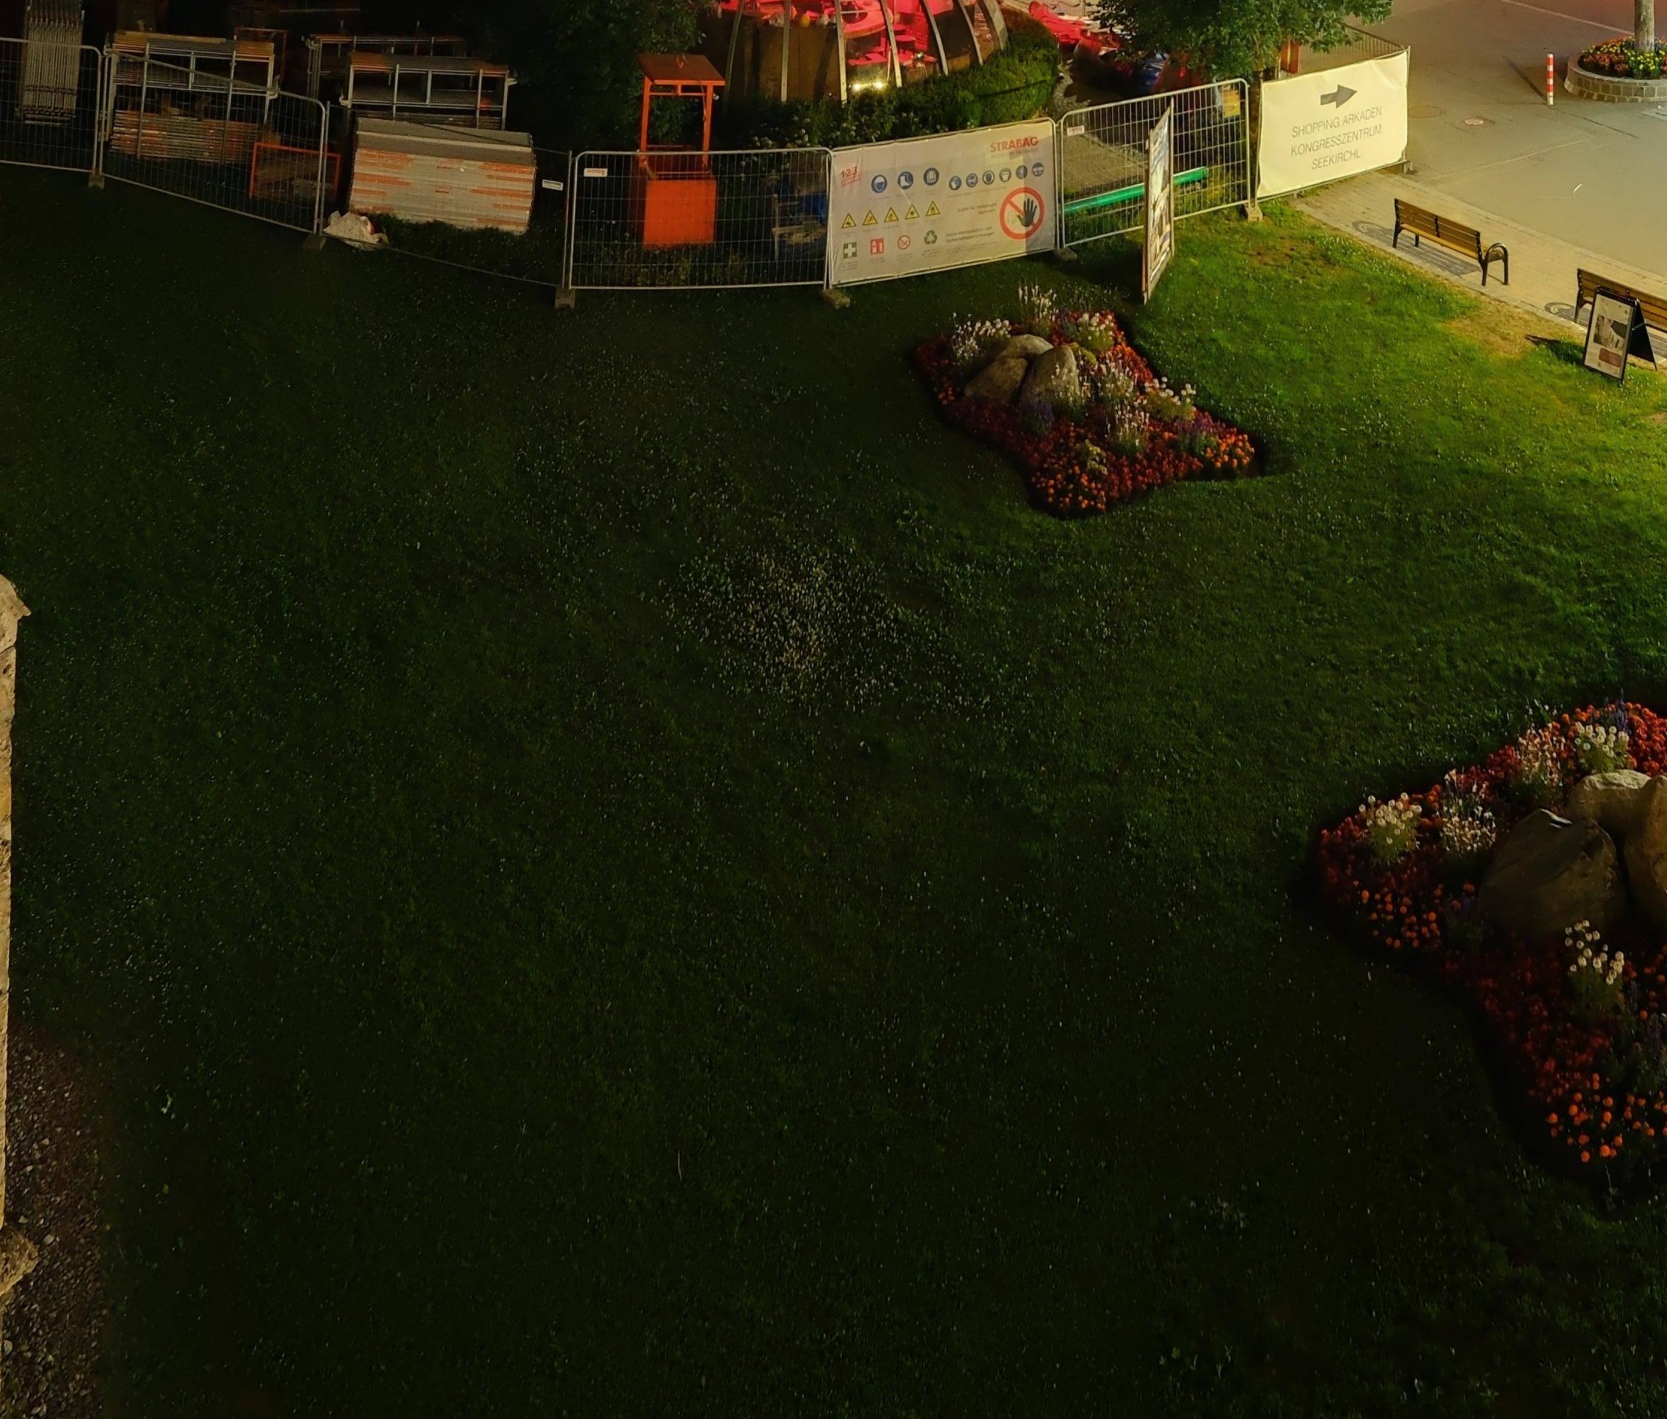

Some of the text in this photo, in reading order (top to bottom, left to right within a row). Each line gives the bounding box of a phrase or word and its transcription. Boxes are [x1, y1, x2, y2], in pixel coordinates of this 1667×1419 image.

[1292, 106, 1382, 138] SHOPPING ARKADEN
[990, 136, 1039, 152] STRABAG
[1291, 124, 1382, 156] KONGRESSZENTRUM
